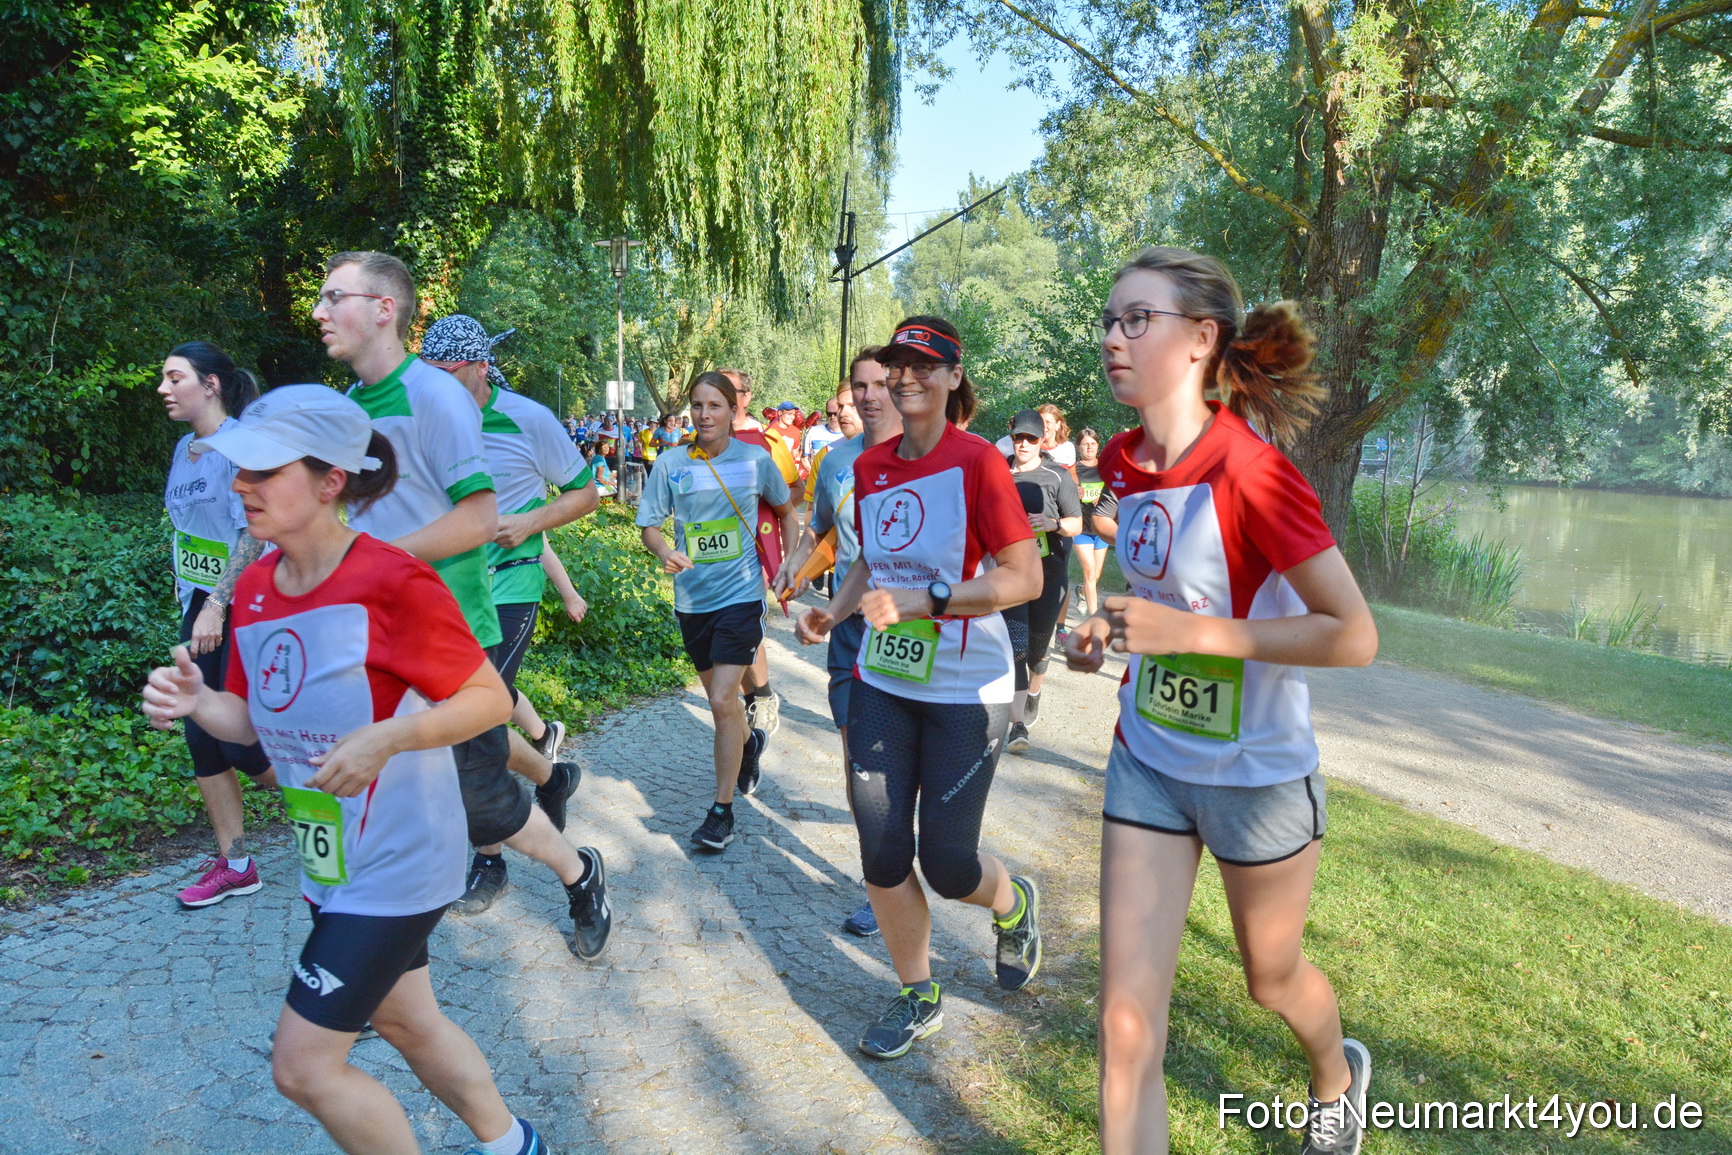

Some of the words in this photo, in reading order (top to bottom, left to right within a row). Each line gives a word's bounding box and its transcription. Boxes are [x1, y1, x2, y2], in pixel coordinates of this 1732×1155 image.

[698, 533, 729, 552] 640
[182, 549, 222, 575] 2043
[893, 561, 913, 570] MIT
[912, 573, 937, 581] Rösch
[875, 632, 925, 663] 1559
[1147, 663, 1218, 714] 1561
[1149, 697, 1180, 715] Führlein
[1181, 709, 1212, 723] Marike
[298, 729, 338, 743] HERZ
[941, 758, 983, 803] SALOMON
